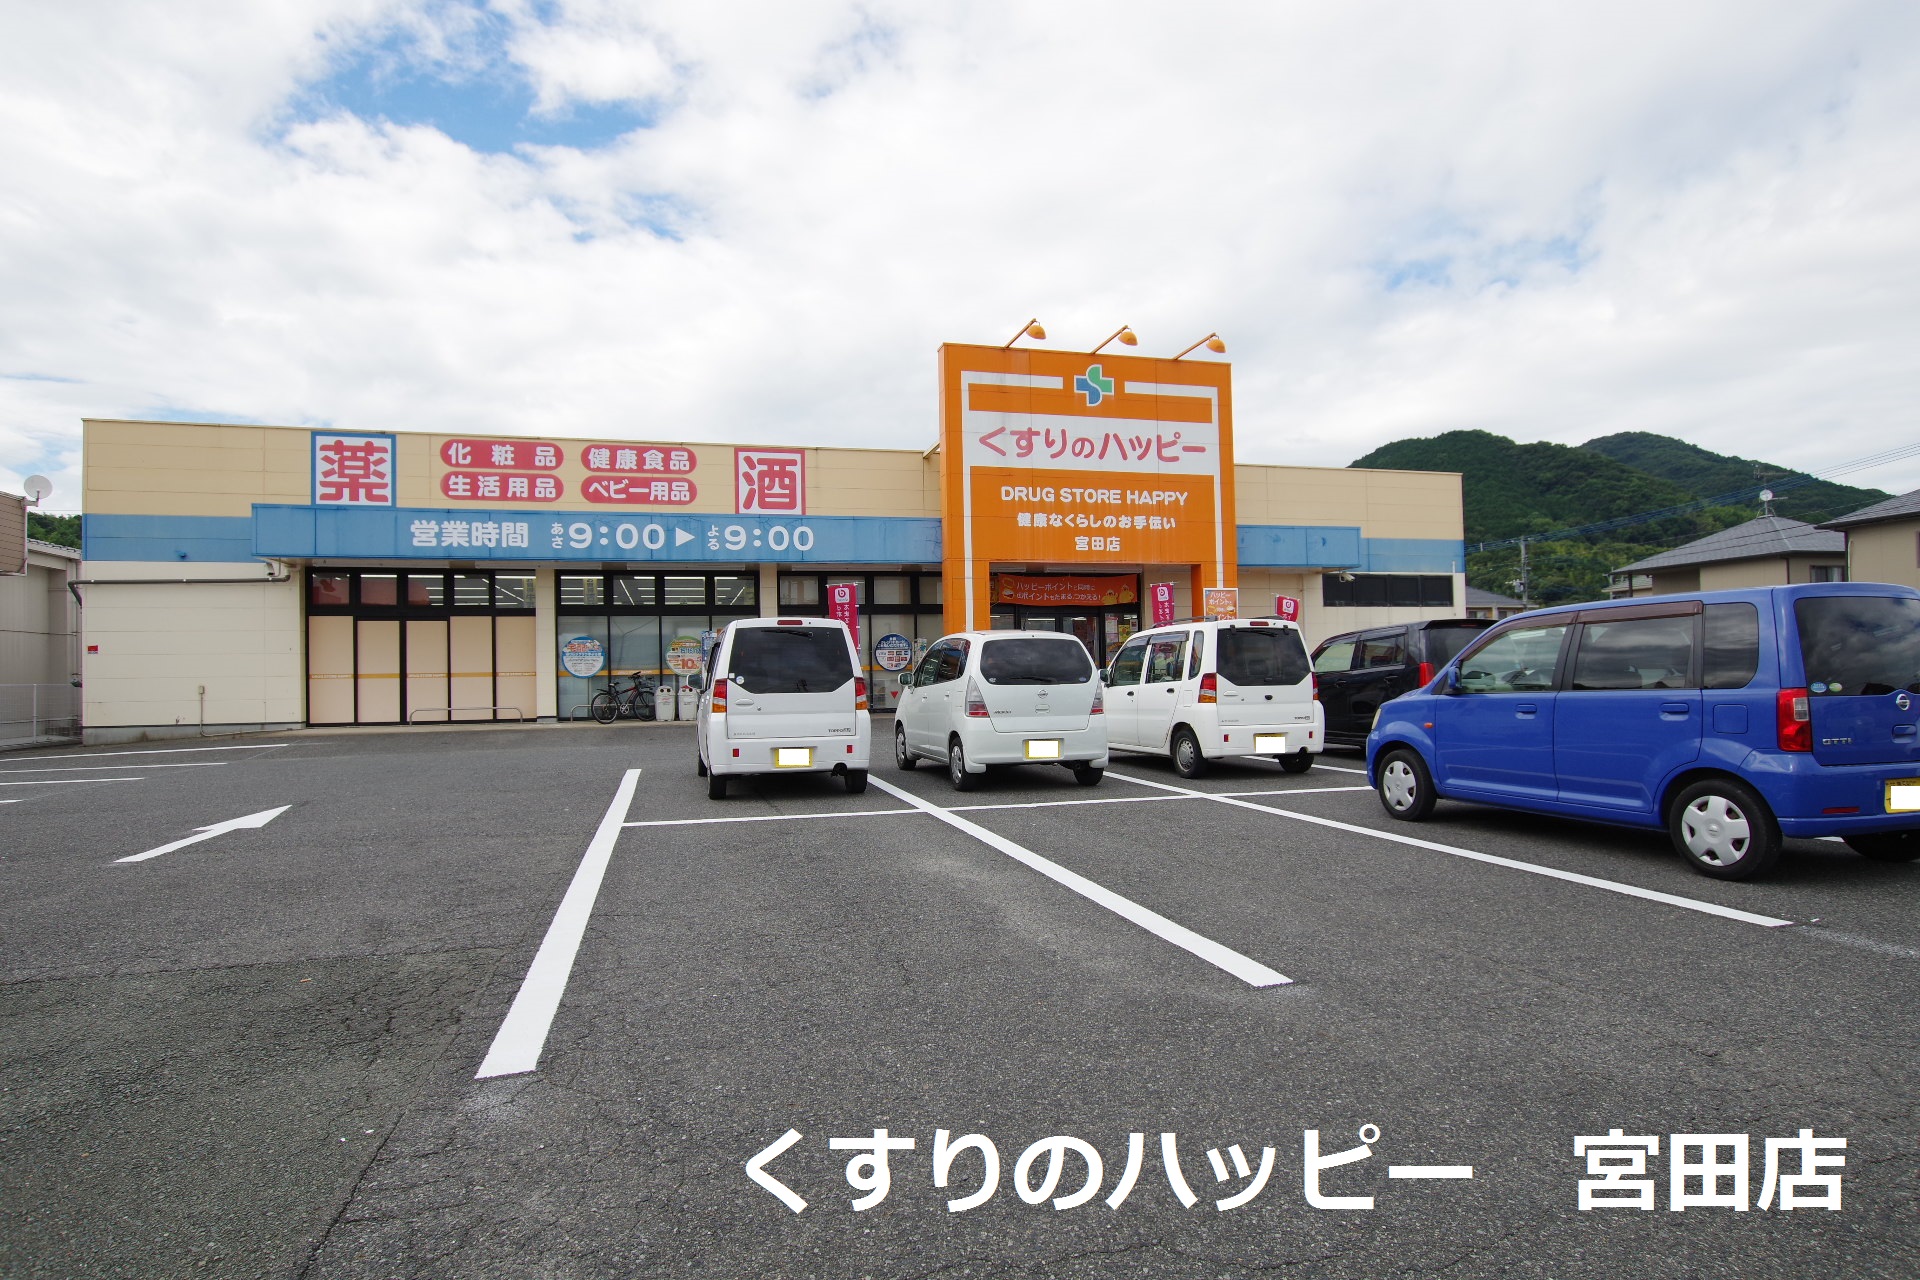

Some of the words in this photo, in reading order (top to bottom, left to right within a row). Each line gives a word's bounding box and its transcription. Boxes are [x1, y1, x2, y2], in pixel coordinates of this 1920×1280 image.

[448, 442, 557, 467] 化粧品
[978, 425, 1207, 463] くすりのハッピー
[318, 439, 389, 503] 薬
[588, 448, 691, 472] 健康食品
[448, 474, 557, 499] 生活用品
[588, 479, 691, 503] ベビー用品
[742, 455, 798, 511] 酒
[1001, 486, 1055, 502] DRUG
[1059, 487, 1121, 504] STORE
[1126, 490, 1188, 506] HAPPY
[1016, 512, 1176, 530] 健康なくらしのお手伝い
[410, 519, 529, 548] 営業時間
[568, 522, 665, 550] 9:00
[724, 524, 814, 551] 9:00
[1074, 535, 1121, 552] 宮田店
